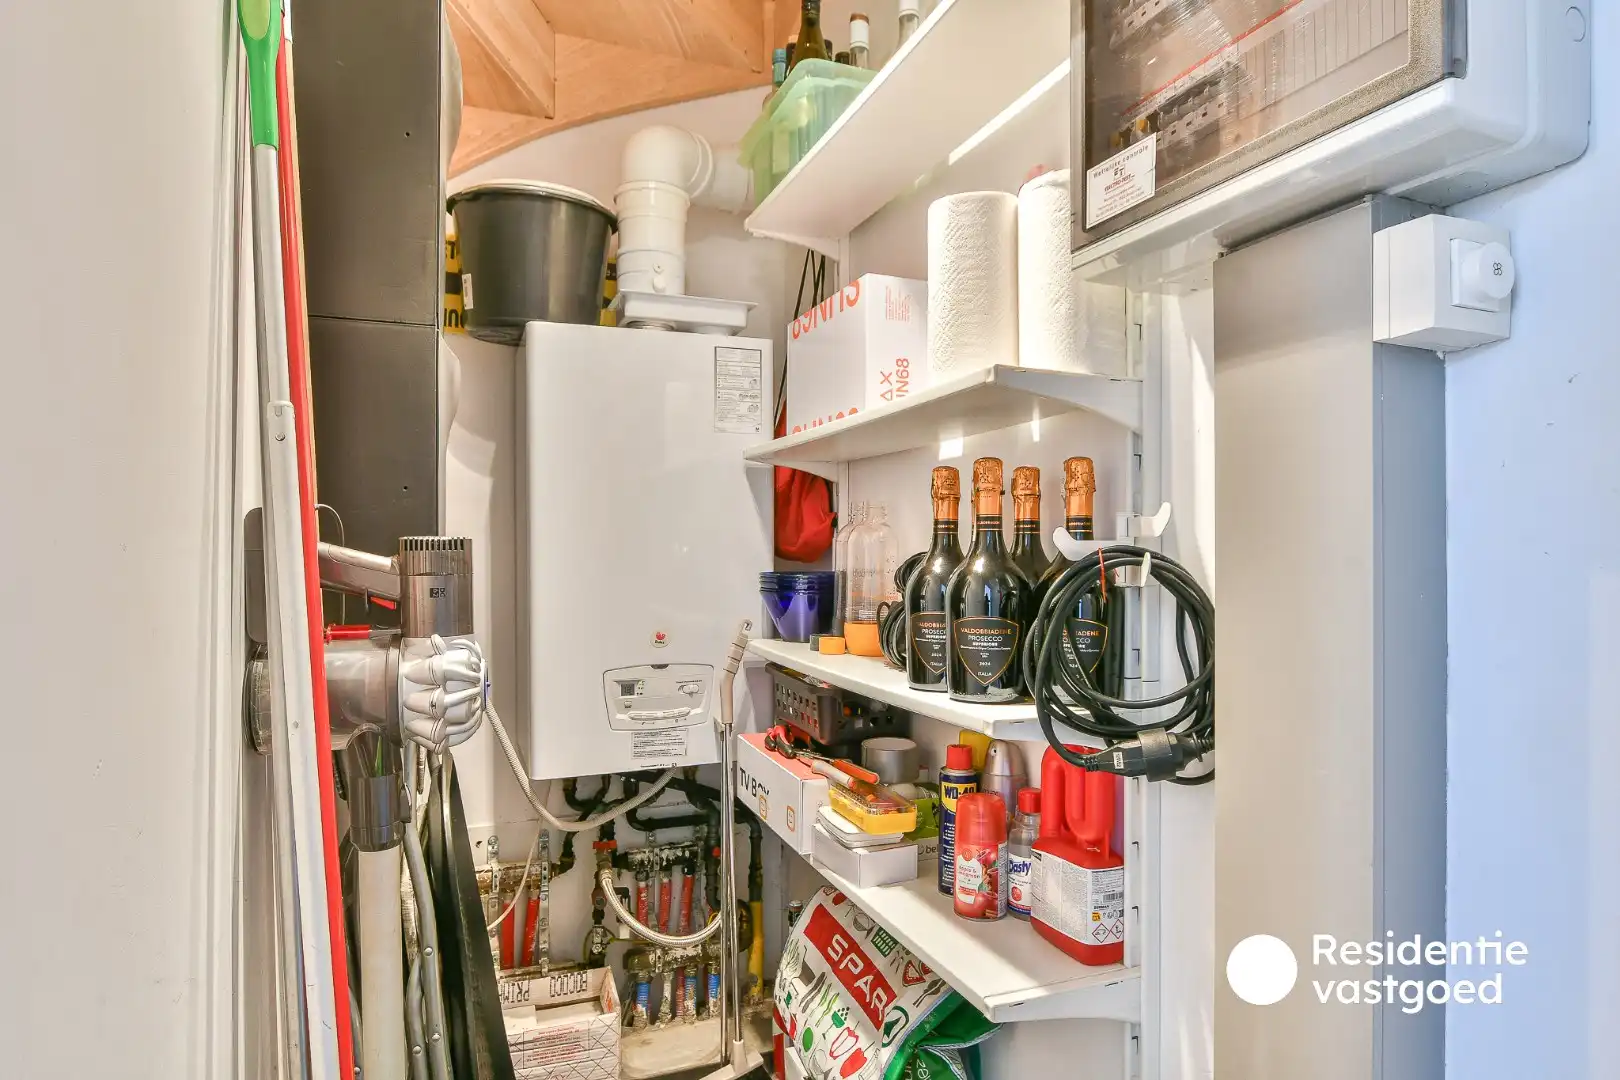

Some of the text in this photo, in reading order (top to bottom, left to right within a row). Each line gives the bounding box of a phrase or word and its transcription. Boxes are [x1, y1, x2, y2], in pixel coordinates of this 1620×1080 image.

[960, 627, 1012, 635] VALDOBBIADENE
[739, 767, 750, 791] TV
[827, 933, 888, 1021] SPAR
